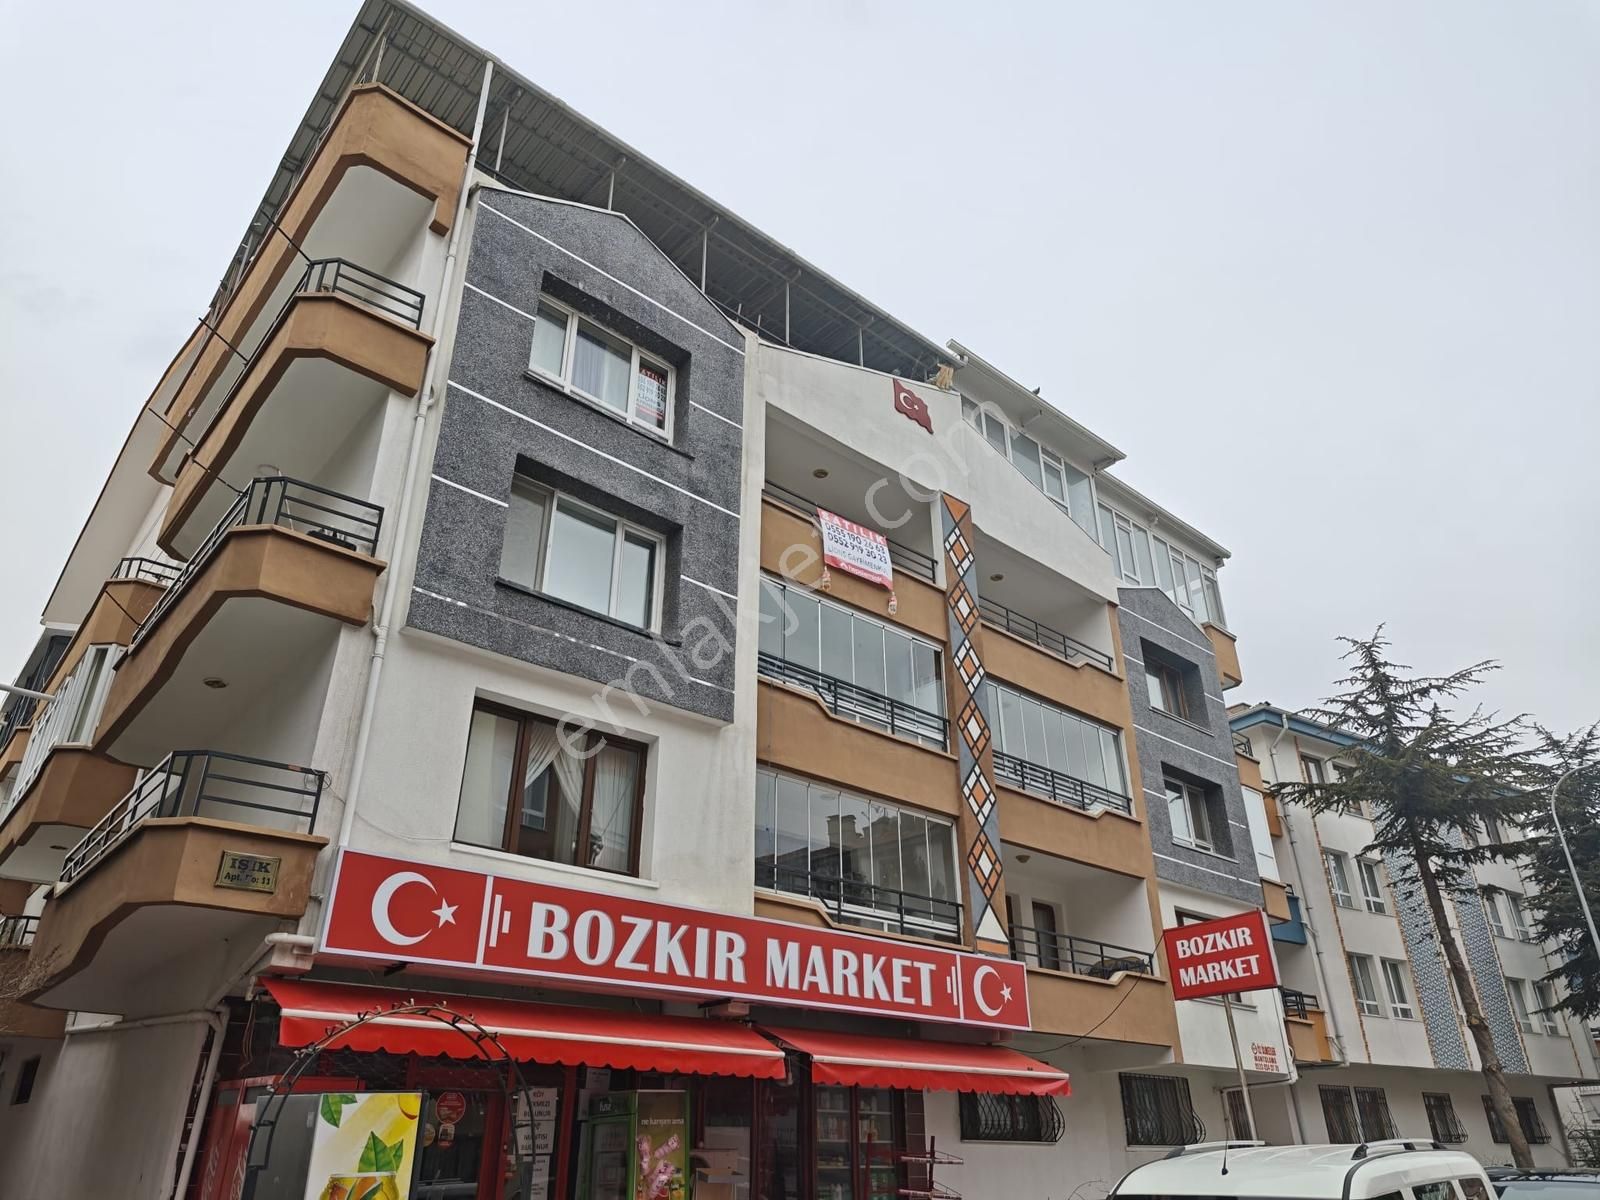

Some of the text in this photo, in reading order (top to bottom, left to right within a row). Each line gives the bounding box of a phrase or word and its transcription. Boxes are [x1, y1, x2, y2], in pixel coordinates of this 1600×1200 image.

[820, 510, 887, 546] SATILIK
[825, 522, 845, 537] 0555
[848, 533, 861, 545] 190
[827, 532, 849, 548] 0552
[262, 876, 270, 885] 11
[526, 901, 936, 1007] BOZKIR MARKET
[1176, 927, 1253, 959] BOZKIR
[1179, 955, 1260, 987] MARKET
